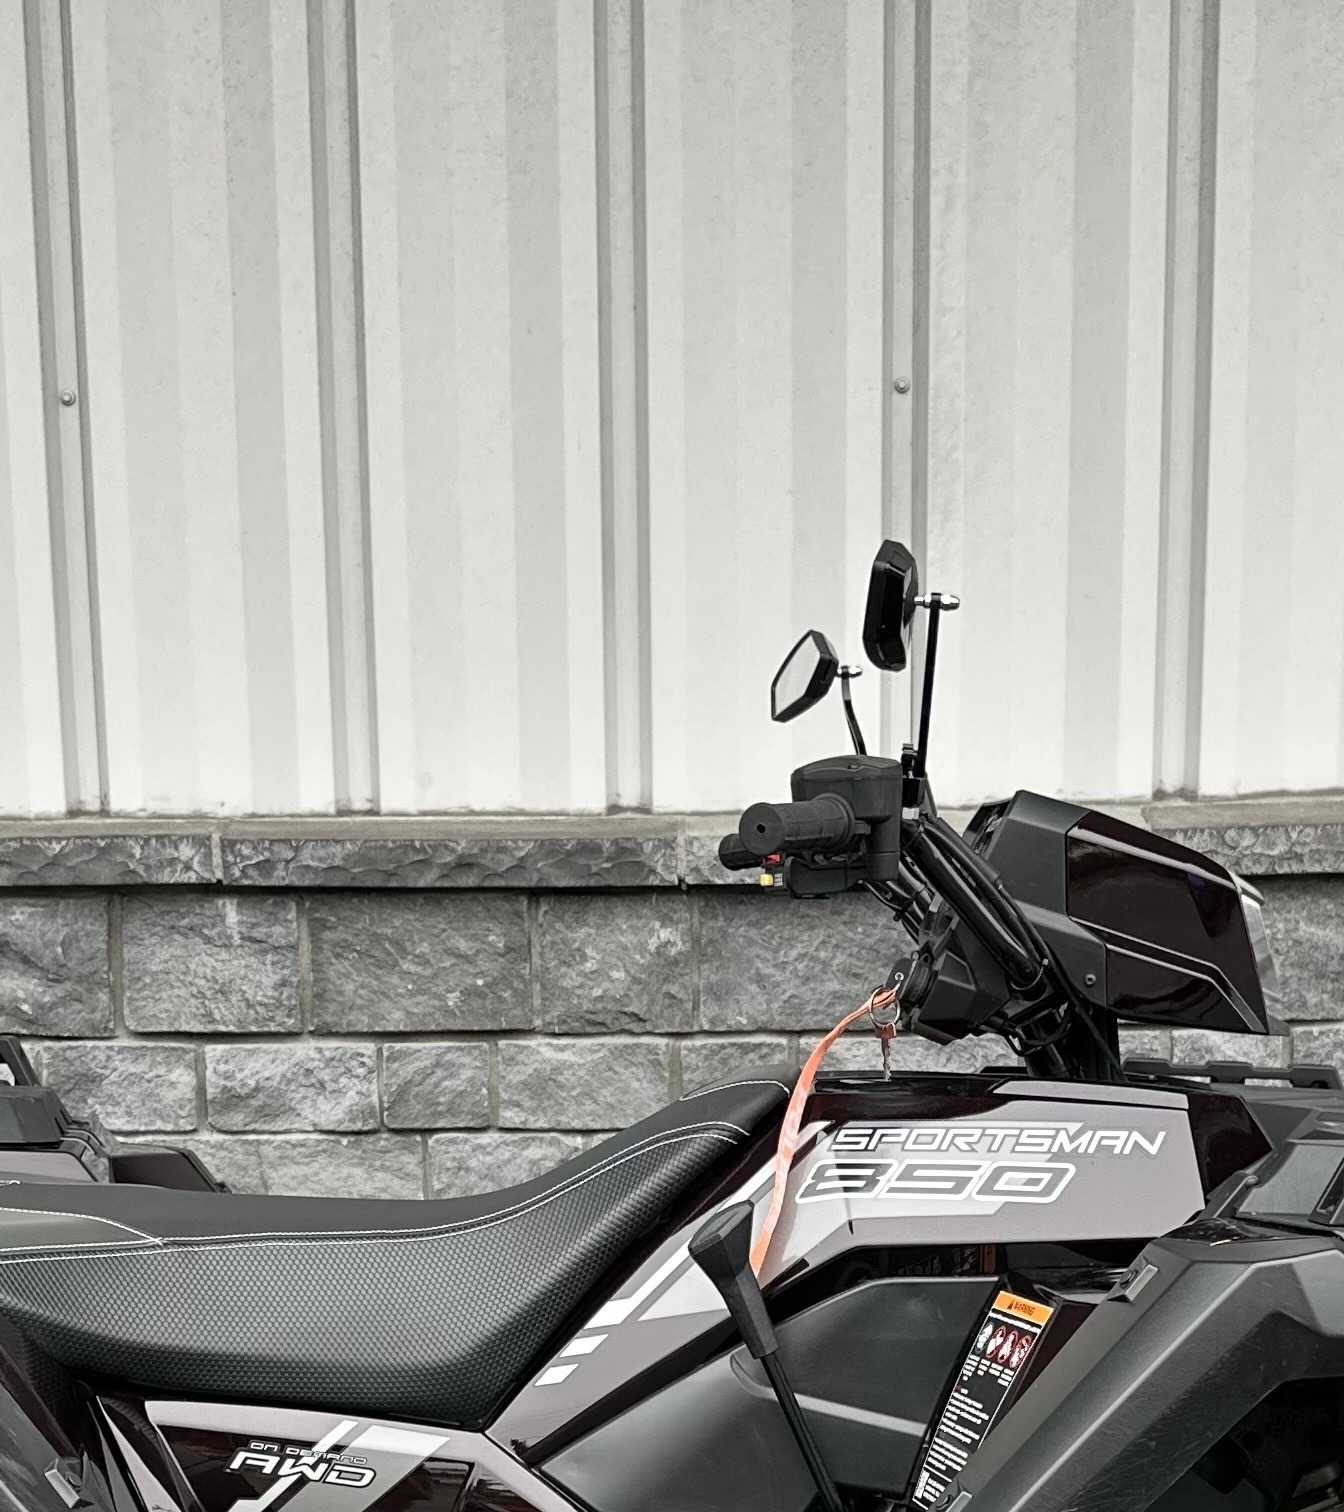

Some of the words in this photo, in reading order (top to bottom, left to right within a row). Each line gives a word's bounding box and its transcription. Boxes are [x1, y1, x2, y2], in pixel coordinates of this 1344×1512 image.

[830, 1127, 1166, 1156] SPORTSMAN
[794, 1158, 1077, 1205] 850
[228, 1450, 377, 1489] AWD
